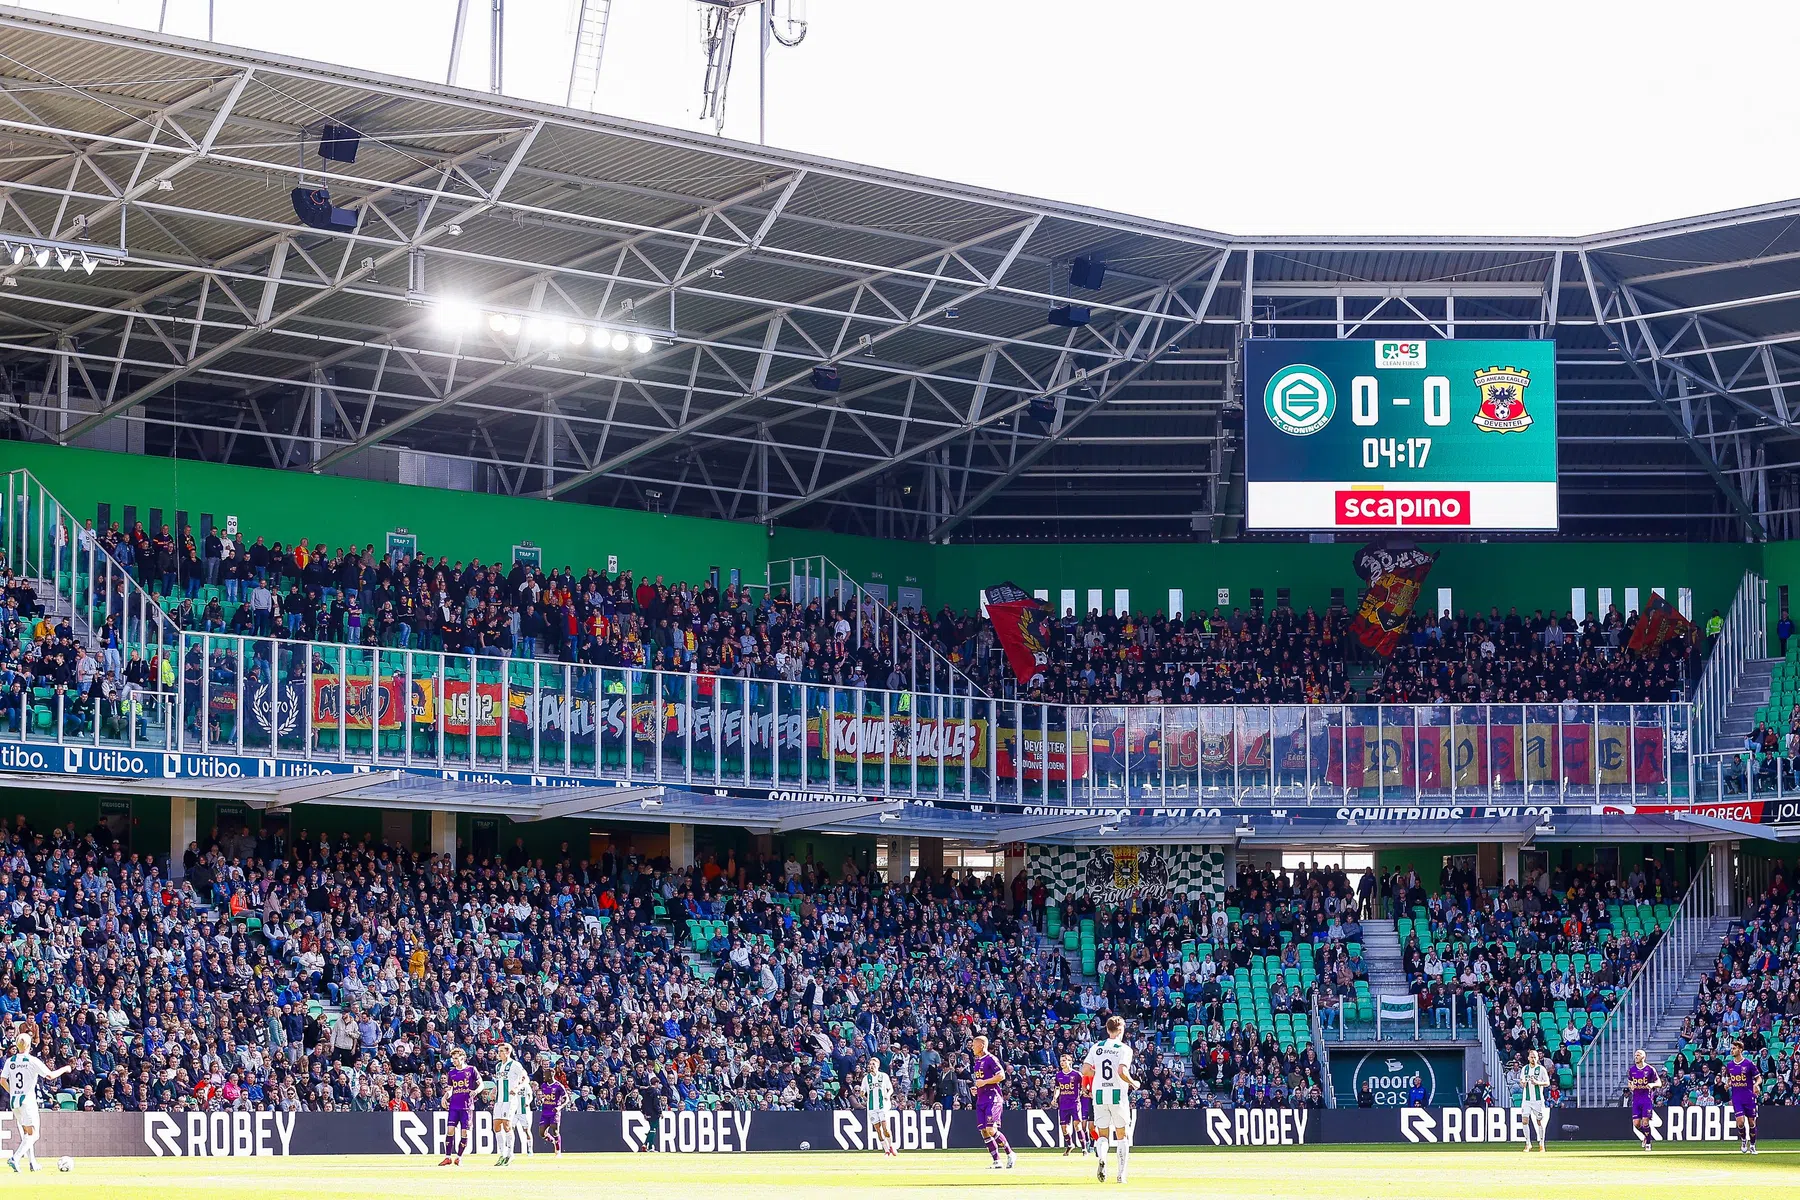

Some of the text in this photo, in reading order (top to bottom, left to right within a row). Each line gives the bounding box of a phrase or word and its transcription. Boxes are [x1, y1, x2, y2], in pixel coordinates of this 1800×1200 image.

[1506, 376, 1528, 385] EAGLES
[1352, 376, 1379, 426] 0
[1423, 376, 1451, 426] 0
[1272, 416, 1329, 434] FC GRONINGEN
[1483, 419, 1523, 428] DEVENTER
[1362, 438, 1432, 468] 04:17
[1344, 494, 1461, 525] scapino
[1024, 739, 1065, 753] DEVETER
[89, 751, 149, 774] Utibo.
[187, 757, 245, 778] Utibo.
[1101, 1058, 1113, 1081] 6
[1368, 1071, 1420, 1089] noord
[1729, 1073, 1747, 1082] bet
[15, 1071, 24, 1090] 3
[452, 1078, 469, 1088] bet
[1059, 1081, 1075, 1090] bet
[187, 1111, 296, 1156] ROBEY
[659, 1110, 752, 1152] ROBEY
[1235, 1109, 1308, 1146] ROBEY
[1667, 1105, 1752, 1141] ROBE
